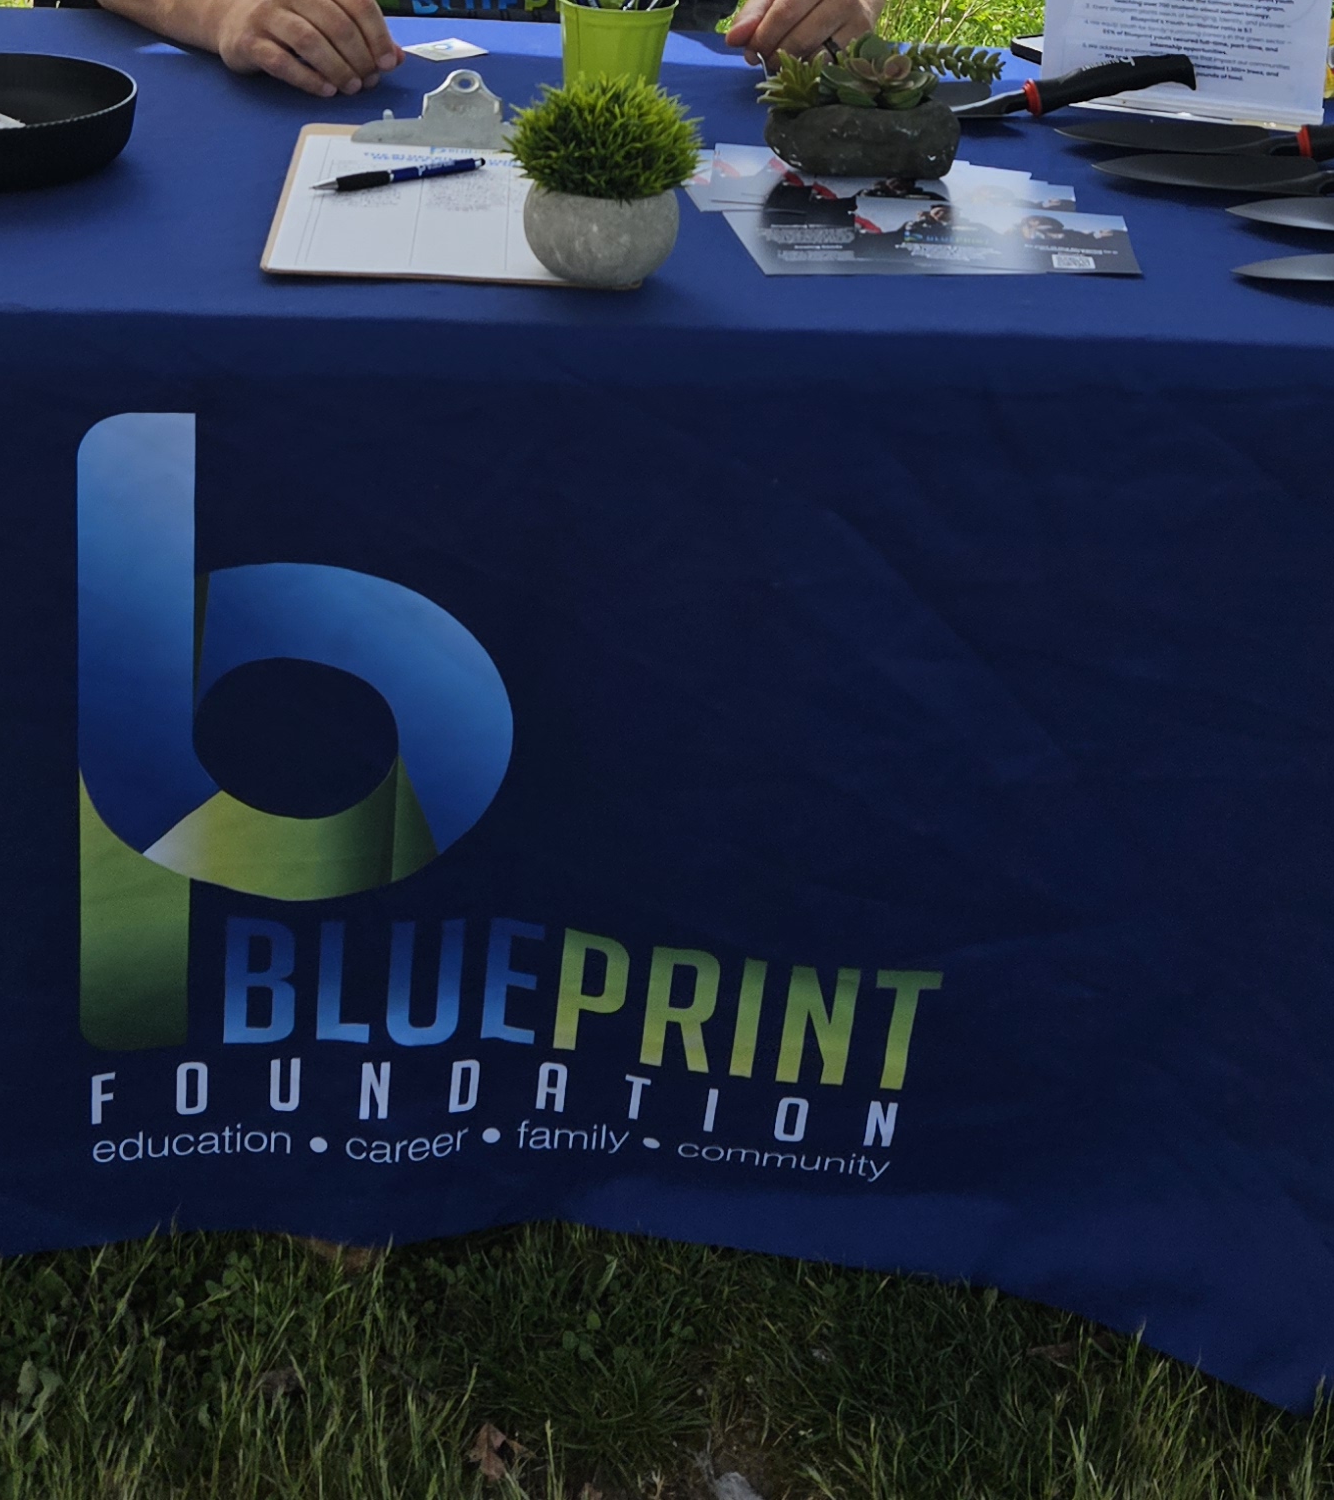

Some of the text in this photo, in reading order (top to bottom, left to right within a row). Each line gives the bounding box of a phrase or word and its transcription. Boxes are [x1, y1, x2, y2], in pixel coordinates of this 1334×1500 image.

[222, 916, 945, 1091] BLUEPRINT
[90, 1056, 899, 1149] FOUNDATION
[91, 1118, 891, 1185] education career family community
